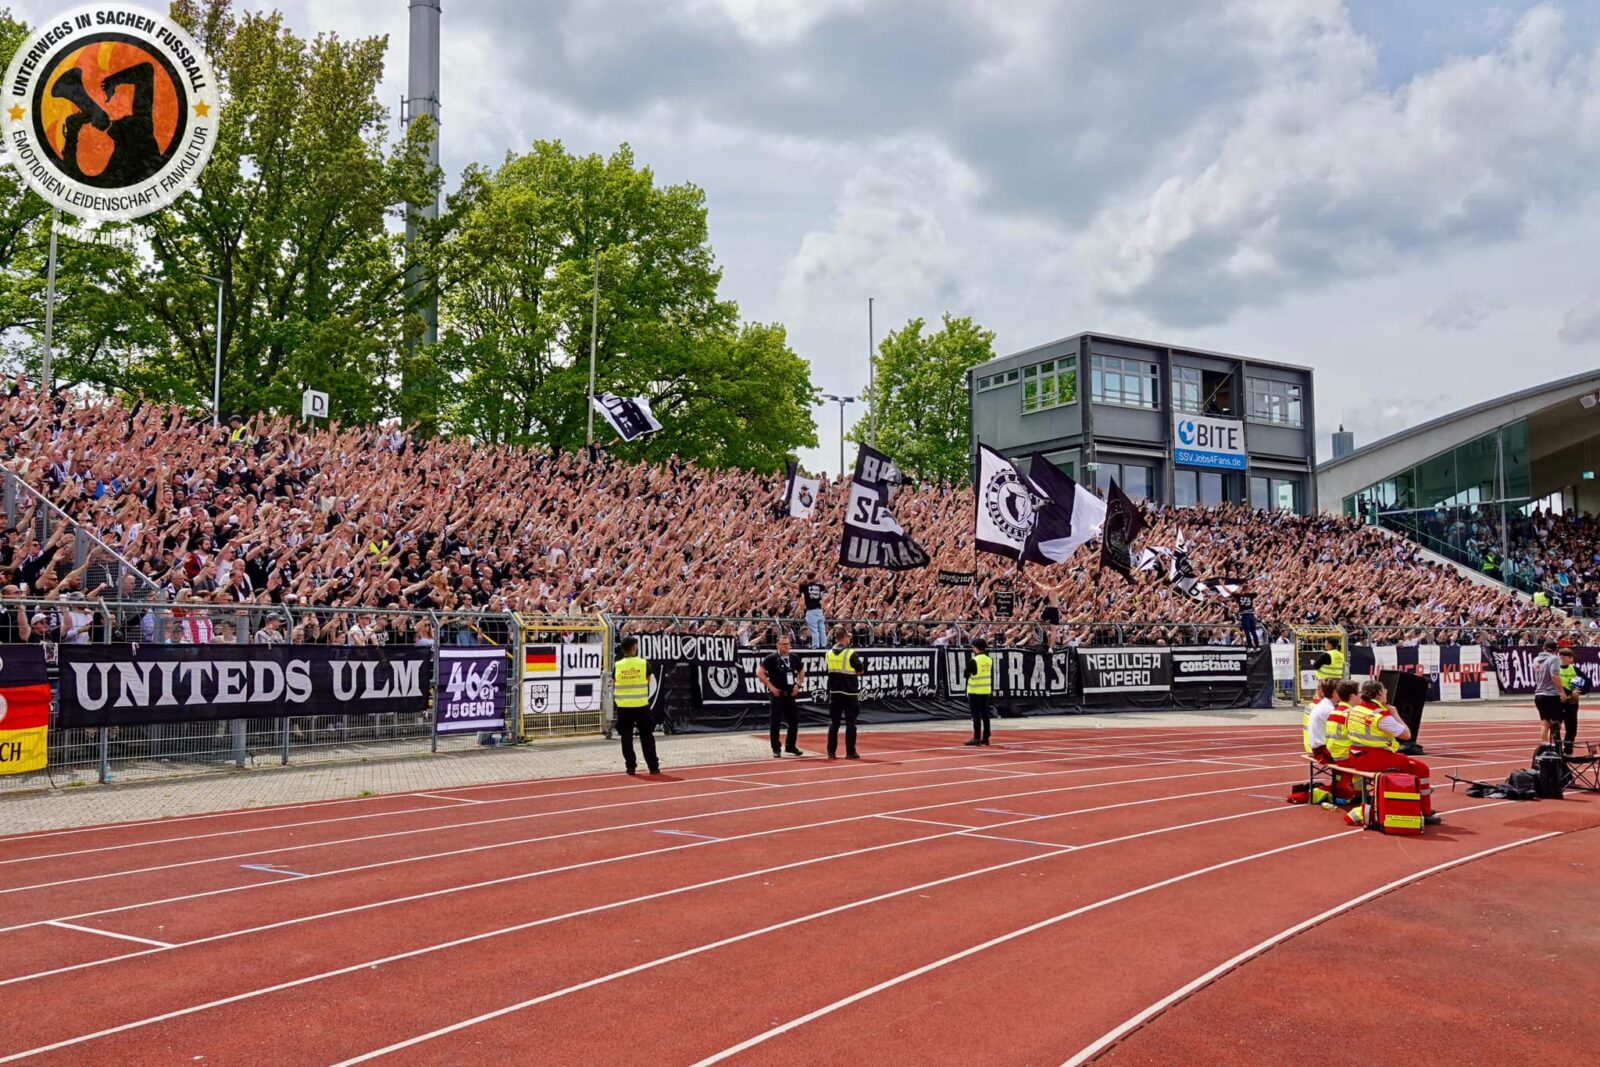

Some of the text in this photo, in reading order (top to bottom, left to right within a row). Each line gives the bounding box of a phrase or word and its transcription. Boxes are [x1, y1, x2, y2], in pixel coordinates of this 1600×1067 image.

[312, 394, 325, 412] D
[1197, 424, 1238, 450] BITE
[1178, 451, 1241, 466] SSV.Jobs4Fans.de
[568, 647, 600, 669] ulm
[697, 636, 735, 662] CREW
[867, 656, 931, 671] ZUSAMMEN
[1086, 653, 1161, 671] NEBULOSA
[1180, 660, 1241, 673] constante
[1275, 657, 1290, 665] 1999
[901, 673, 930, 687] WEG
[947, 651, 1066, 692] UTRAS
[1099, 670, 1151, 687] IMPERO
[1443, 663, 1489, 684] KURVE
[69, 659, 424, 711] UNITEDS ULM
[532, 684, 548, 692] SSV
